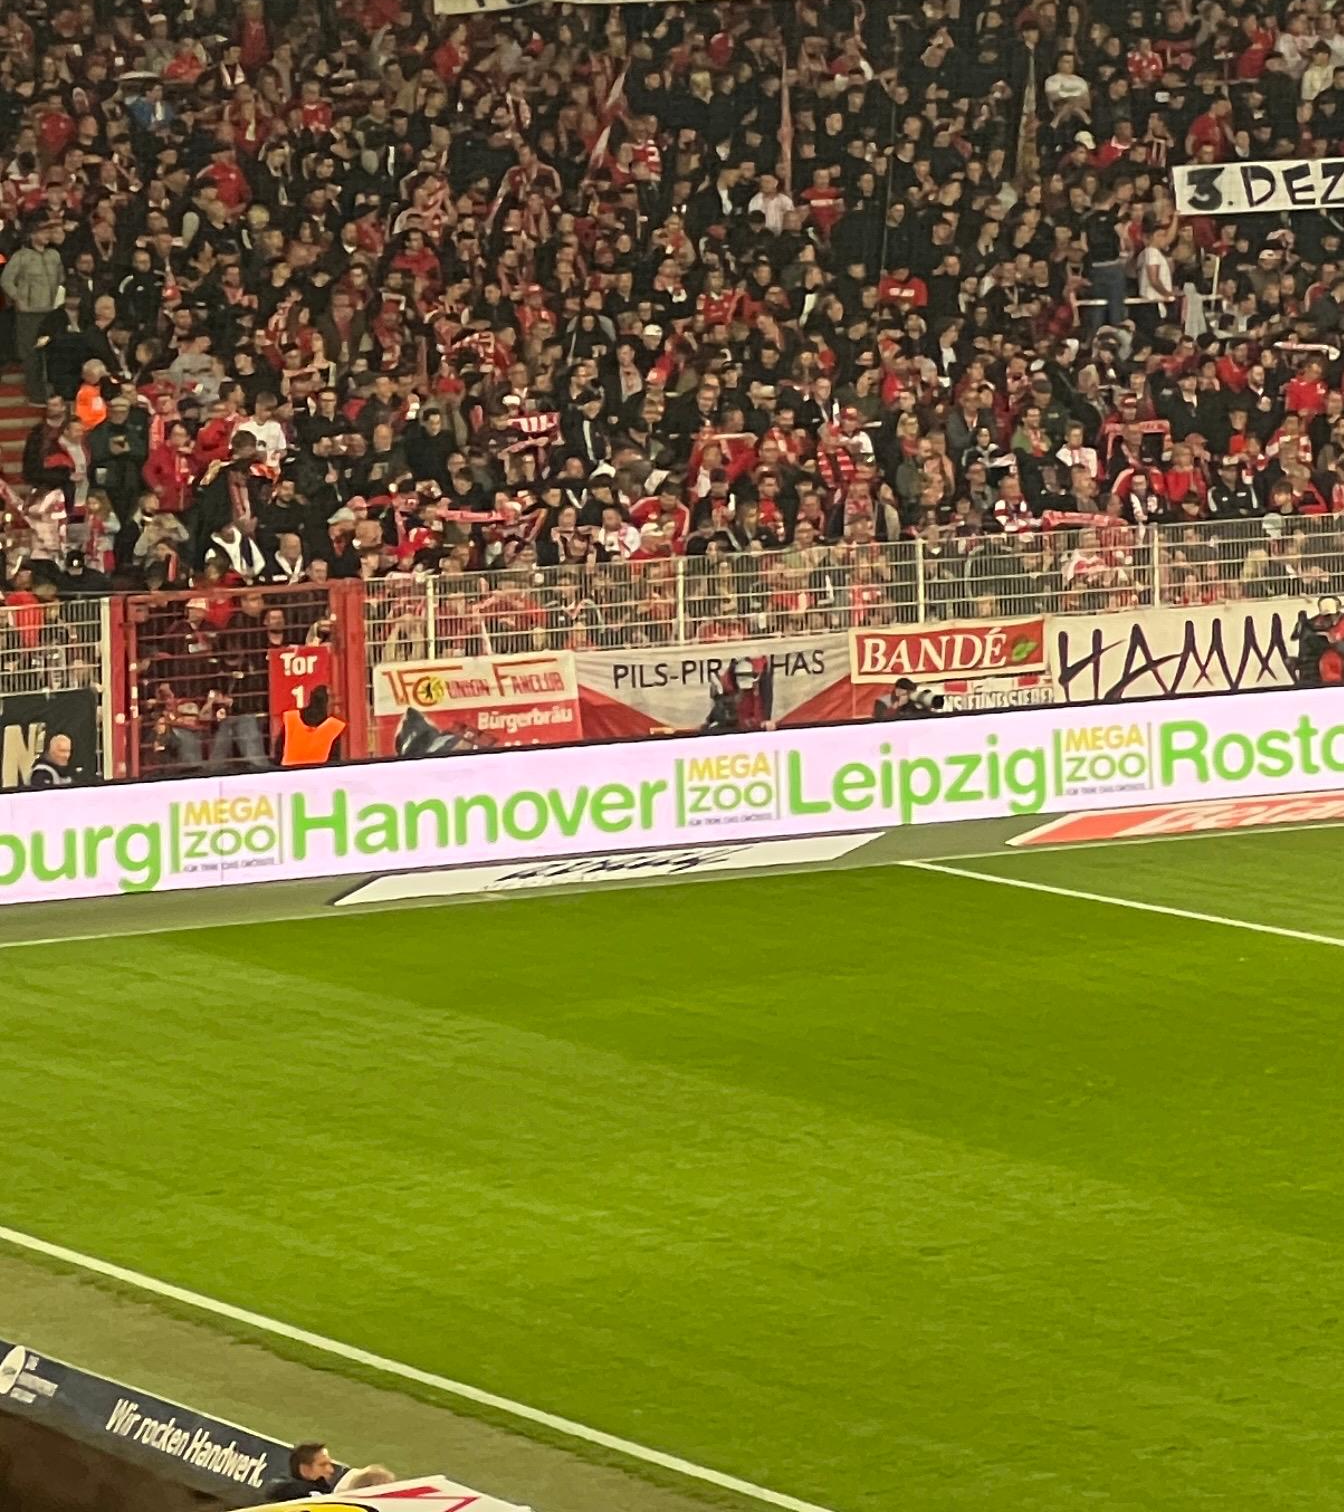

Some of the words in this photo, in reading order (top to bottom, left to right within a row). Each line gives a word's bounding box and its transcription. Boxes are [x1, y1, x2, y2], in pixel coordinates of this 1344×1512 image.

[281, 652, 318, 676] Tor
[860, 627, 1008, 674] BANDÉ
[477, 705, 573, 734] Bürgerbräu
[1065, 723, 1144, 752] MEGA
[688, 751, 772, 781] MEGA
[788, 734, 1047, 825] Leipzig
[1065, 752, 1147, 782] ZOO
[184, 794, 274, 826] MEGA
[688, 781, 774, 813] ZOO
[290, 779, 669, 860] Hannover
[183, 824, 277, 858] ZOO
[105, 1397, 141, 1436] Wir
[133, 1417, 191, 1458] rocken
